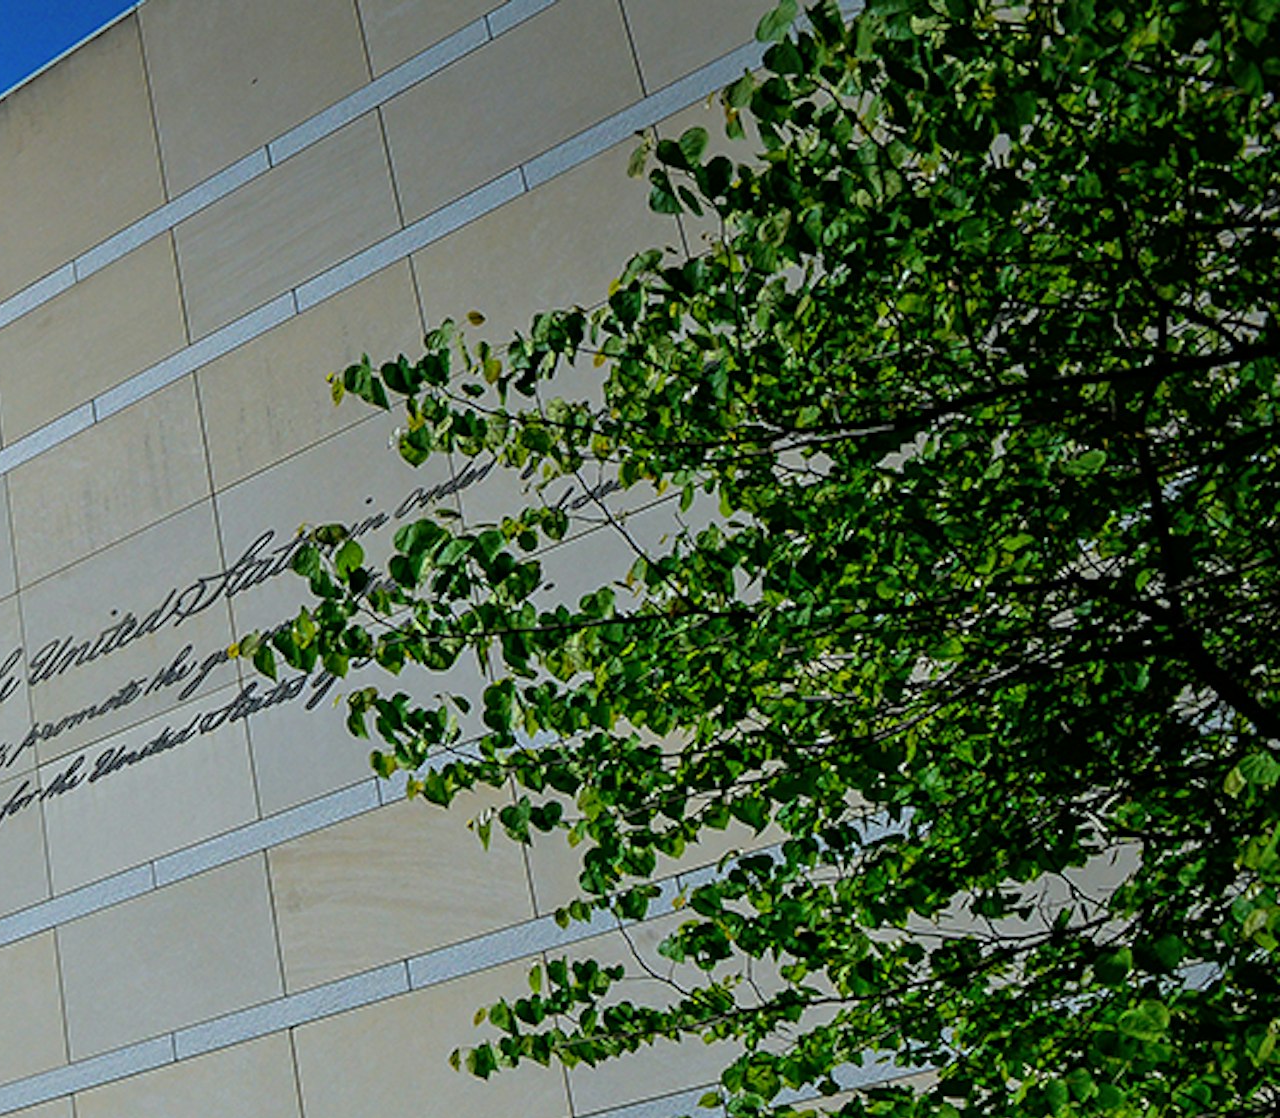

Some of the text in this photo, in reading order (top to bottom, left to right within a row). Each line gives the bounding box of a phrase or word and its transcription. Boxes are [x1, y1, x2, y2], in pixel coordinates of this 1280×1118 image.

[27, 588, 178, 687] United
[6, 677, 148, 768] promote
[143, 644, 198, 696] the
[39, 754, 88, 802] the
[88, 712, 203, 783] United
[198, 674, 308, 735] States
